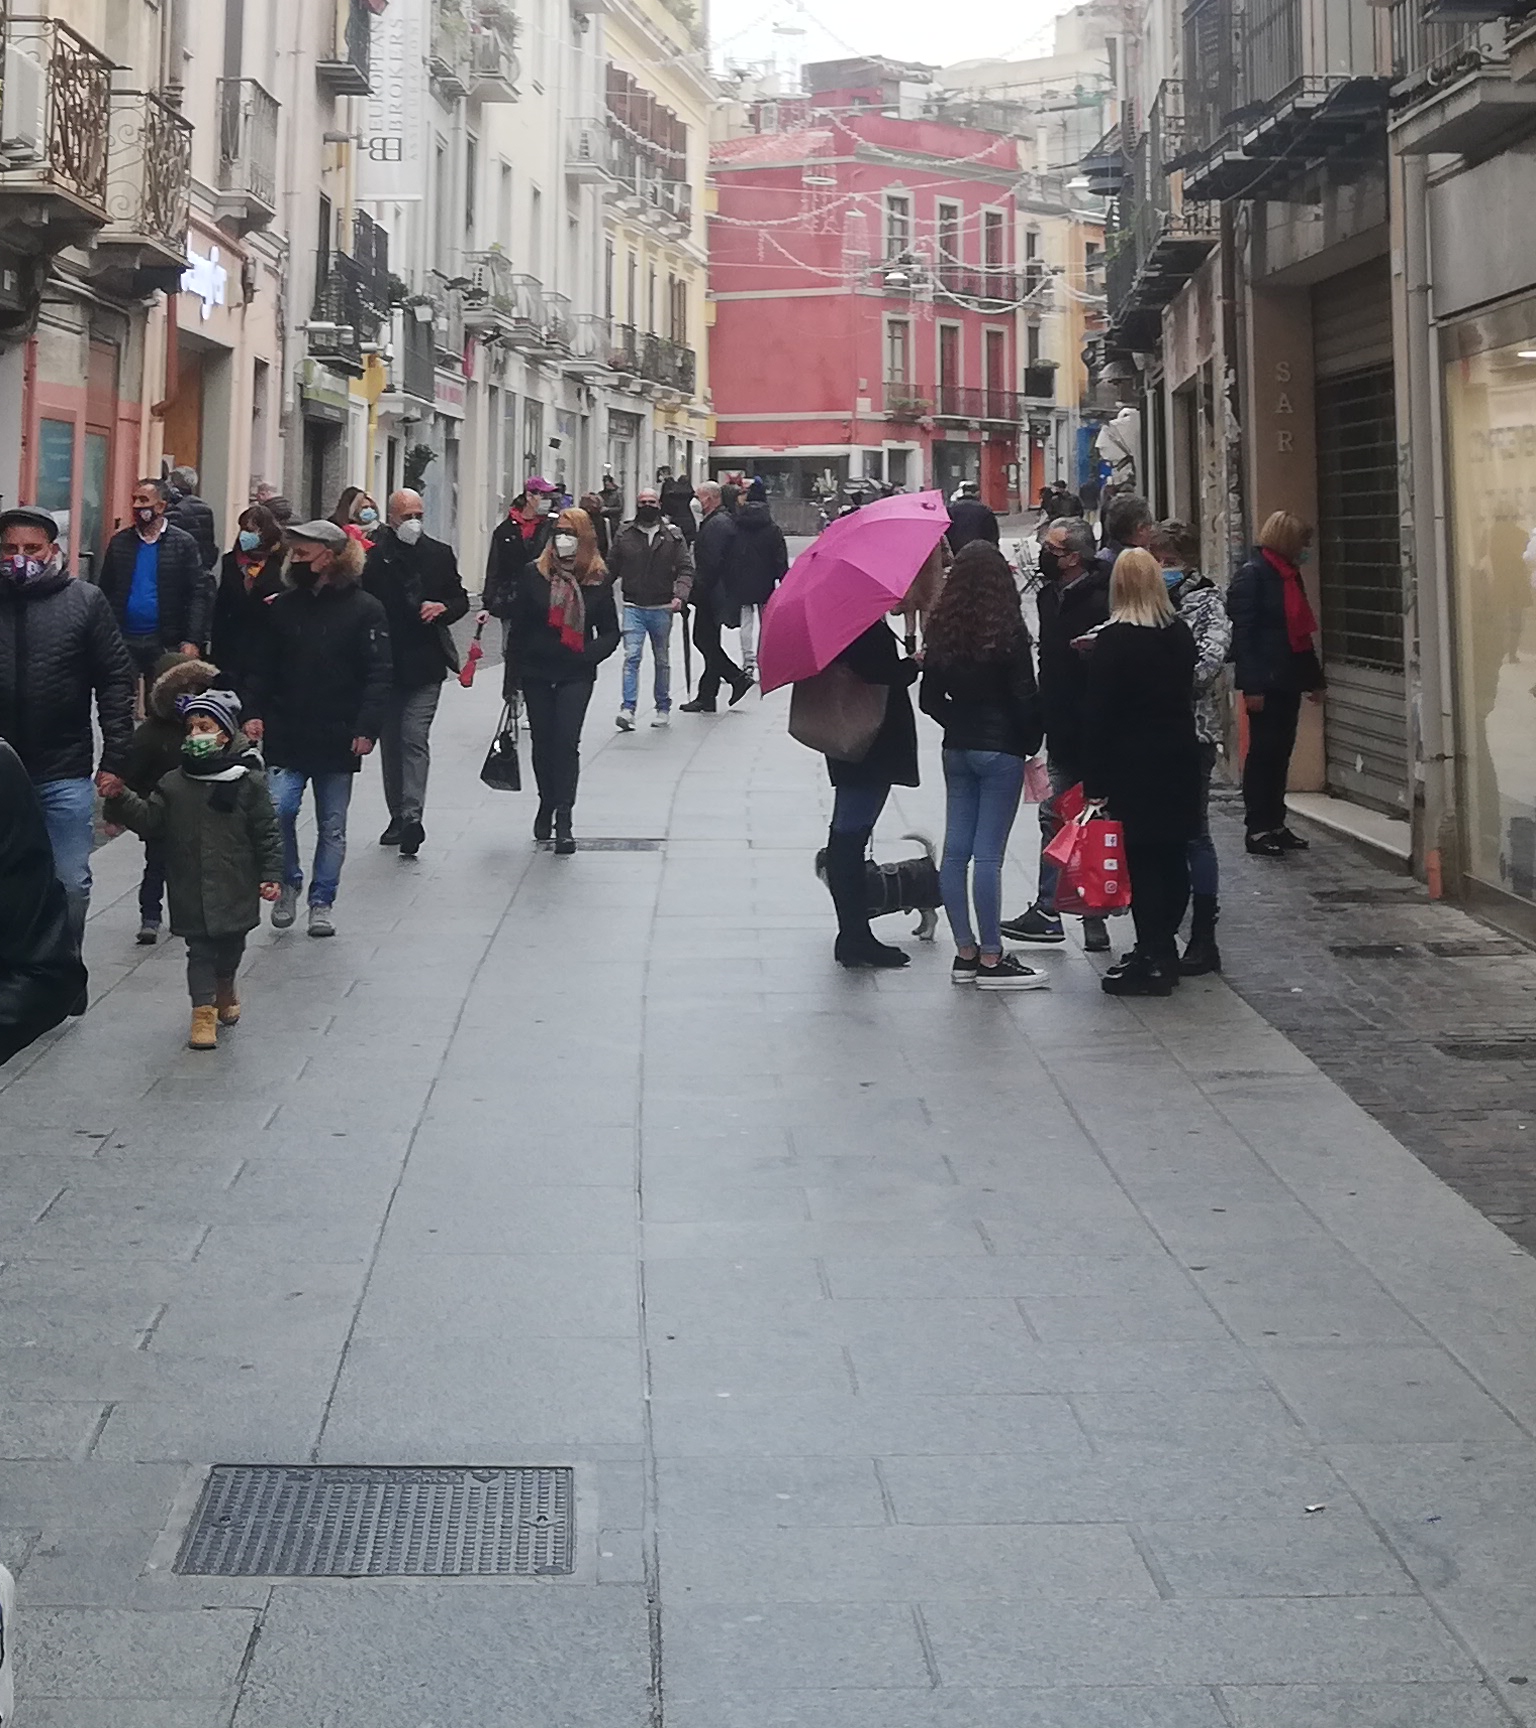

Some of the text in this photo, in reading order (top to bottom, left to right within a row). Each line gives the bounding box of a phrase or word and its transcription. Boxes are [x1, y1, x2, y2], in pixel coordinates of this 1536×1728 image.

[368, 20, 384, 132] EUROPEAN
[388, 18, 403, 132] BROKERS
[407, 18, 419, 161] ASSICURAZIONI
